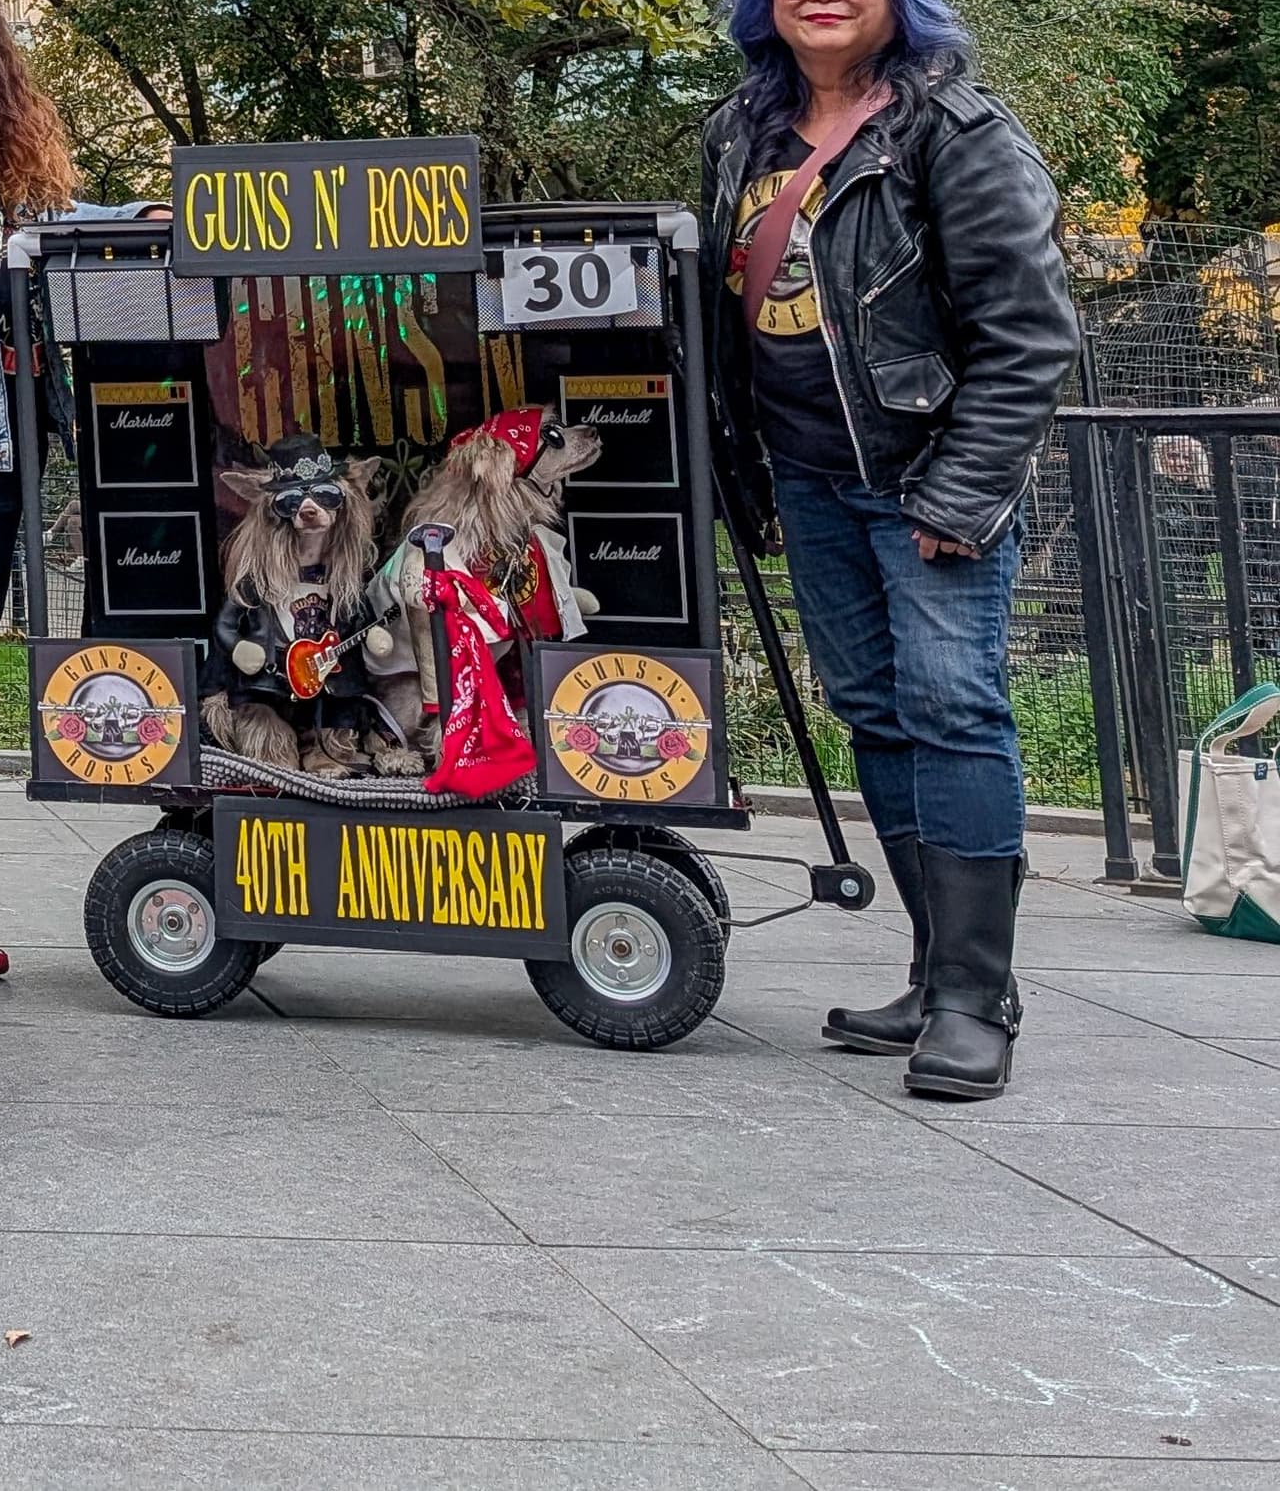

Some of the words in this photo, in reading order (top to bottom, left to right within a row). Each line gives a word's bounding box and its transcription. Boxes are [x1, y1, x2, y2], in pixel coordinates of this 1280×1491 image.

[184, 170, 292, 252] GUNS
[313, 166, 347, 251] N'
[366, 165, 470, 249] ROSES
[521, 253, 612, 313] 30
[110, 410, 174, 429] Marshall
[581, 405, 653, 424] Marshall
[117, 547, 182, 566] Marshall
[589, 541, 662, 561] Marshall
[63, 649, 128, 683] GUNS
[573, 656, 648, 690] GUNS
[66, 748, 155, 783] ROSES
[576, 761, 676, 800] ROSES
[236, 817, 310, 916] 40TH
[337, 824, 546, 930] ANNIVERSARY
